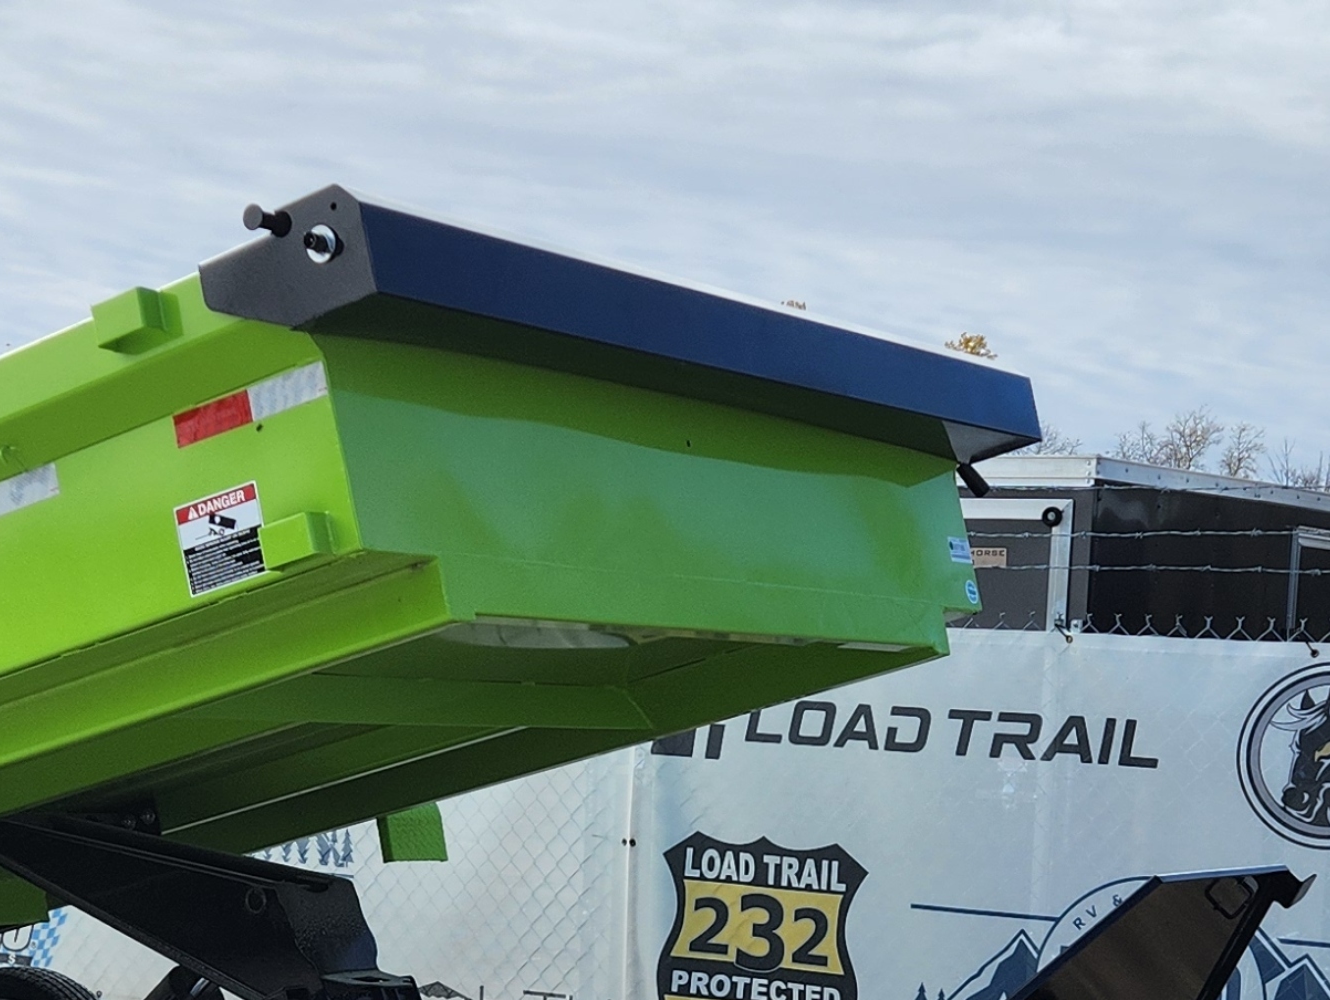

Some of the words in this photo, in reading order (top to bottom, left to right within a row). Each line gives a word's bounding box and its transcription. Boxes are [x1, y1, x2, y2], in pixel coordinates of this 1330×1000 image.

[197, 489, 246, 516] DANGER
[744, 699, 932, 753] LOAD
[947, 708, 1159, 769] TRAIL
[683, 846, 756, 883] LOAD
[763, 853, 847, 893] TRAIL
[688, 893, 829, 972] 232
[1072, 904, 1099, 931] RV
